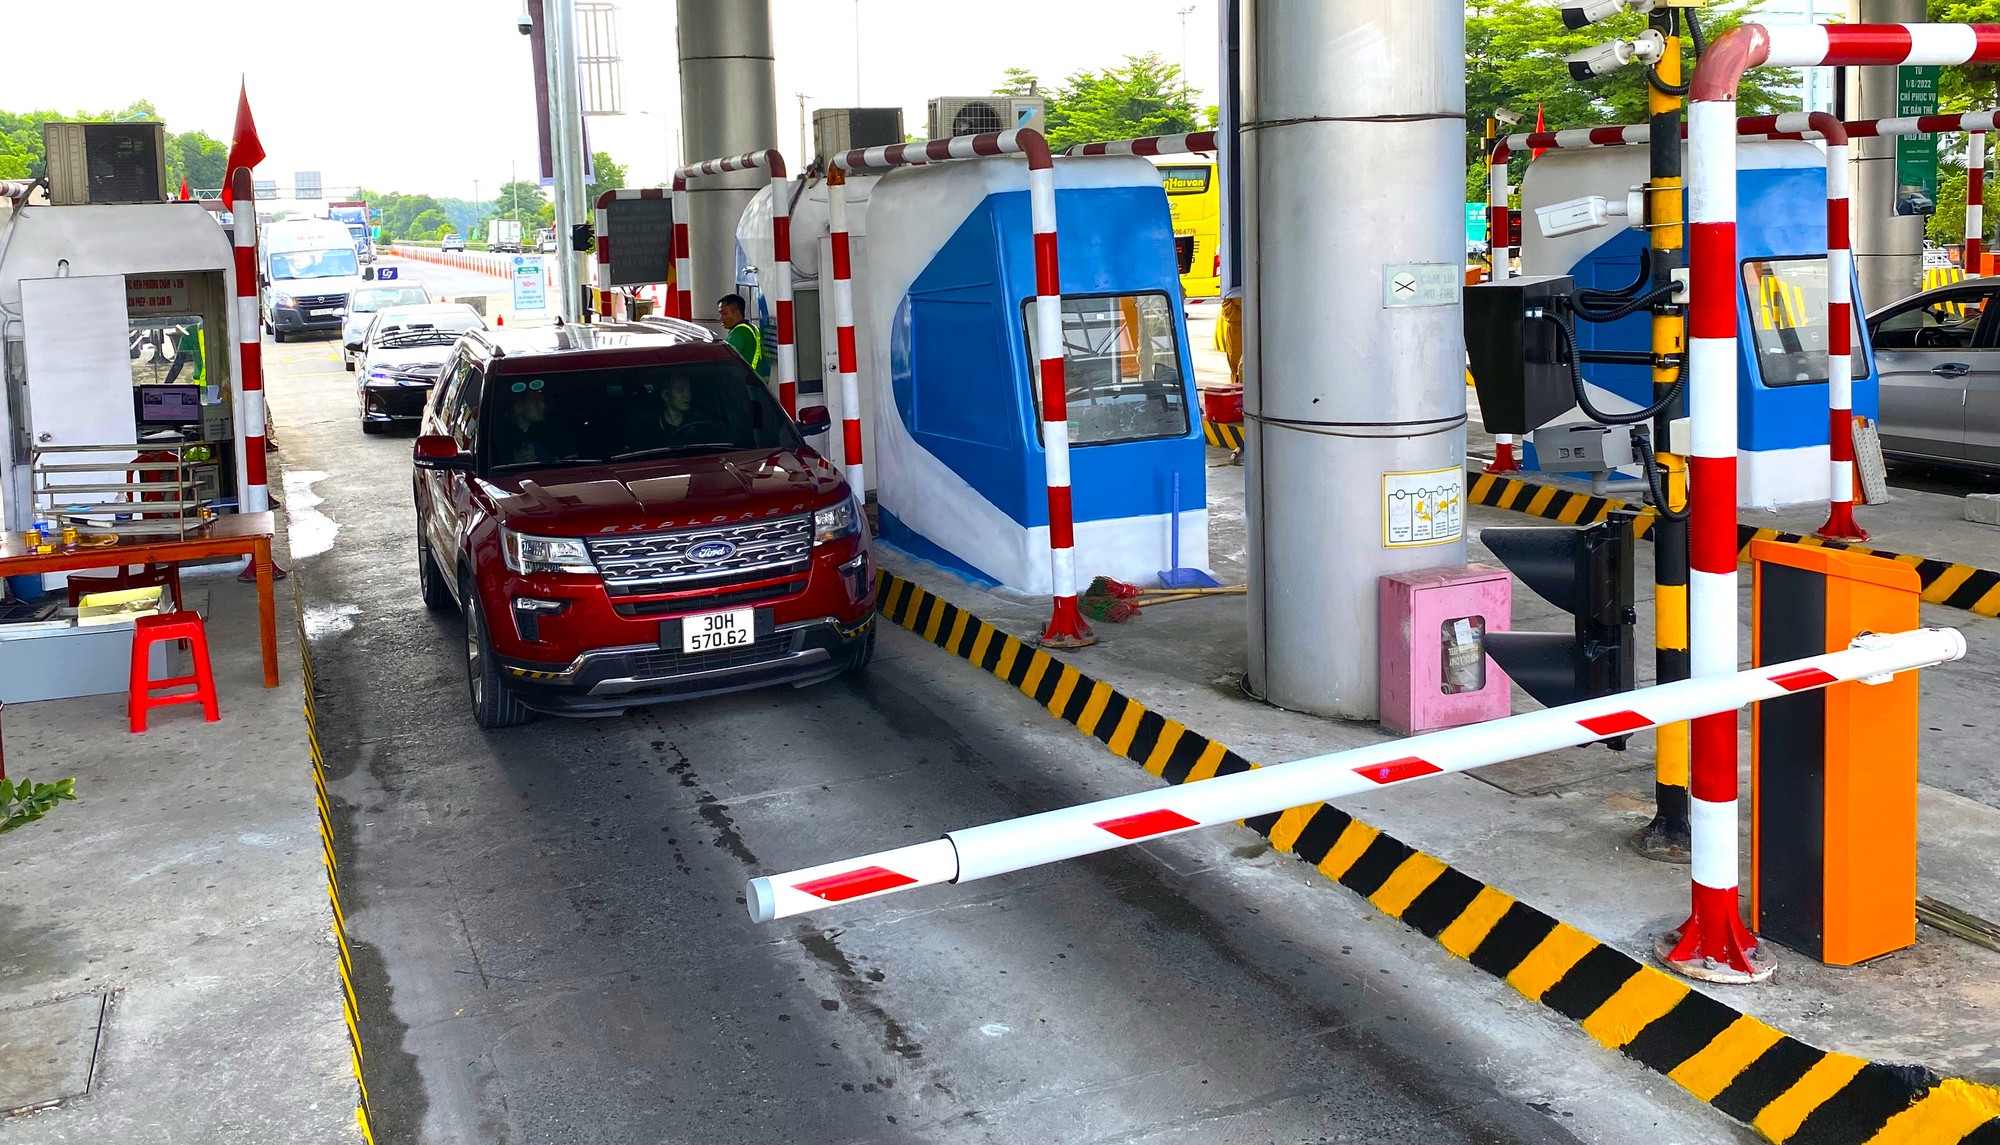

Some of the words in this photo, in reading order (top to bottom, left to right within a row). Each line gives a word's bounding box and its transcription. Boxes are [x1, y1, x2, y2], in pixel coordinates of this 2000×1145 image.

[1905, 79, 1932, 88] 1/8/2022
[1902, 105, 1910, 115] XE
[599, 503, 805, 533] EXPLORER
[698, 545, 726, 558] Ford
[703, 613, 735, 632] 30H
[691, 628, 748, 651] 570.62
